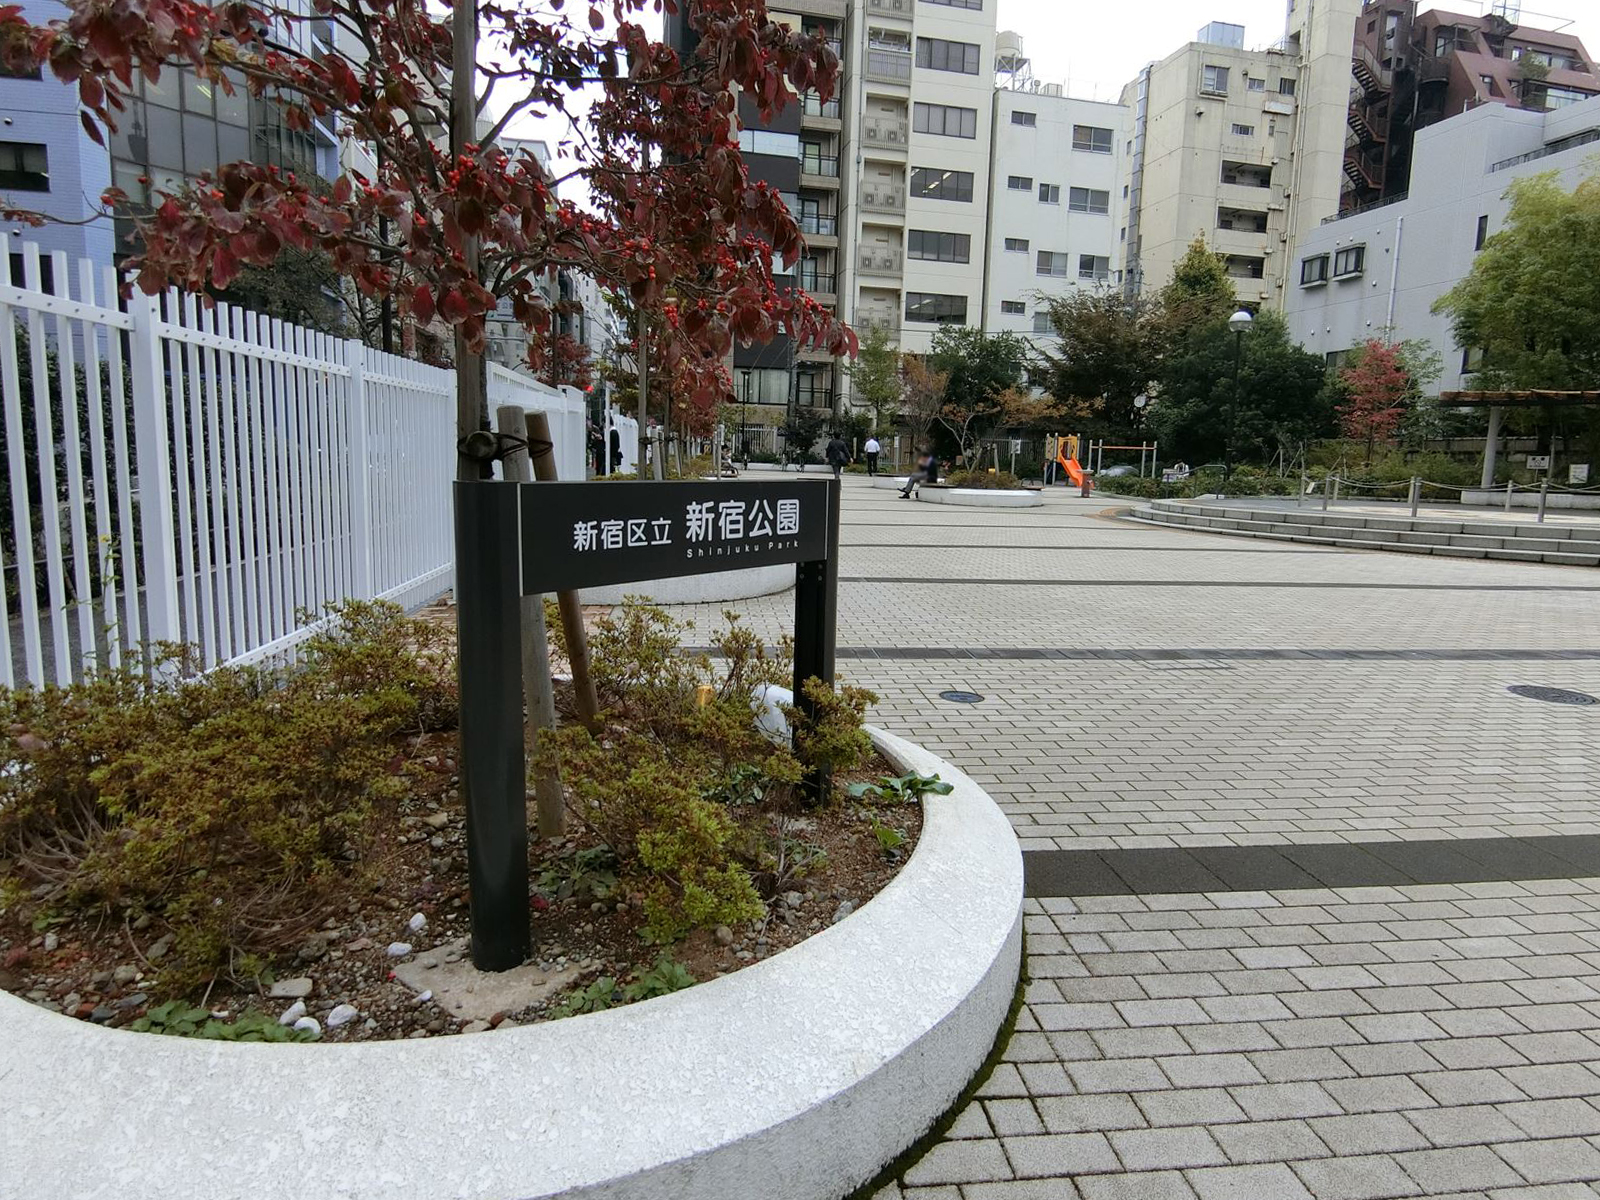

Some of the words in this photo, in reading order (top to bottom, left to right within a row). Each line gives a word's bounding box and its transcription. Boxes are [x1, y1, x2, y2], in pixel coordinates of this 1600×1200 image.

[573, 517, 672, 551] 新宿区立
[686, 499, 799, 542] 新宿公園
[686, 544, 759, 558] Shinjuku
[768, 540, 799, 550] Park
